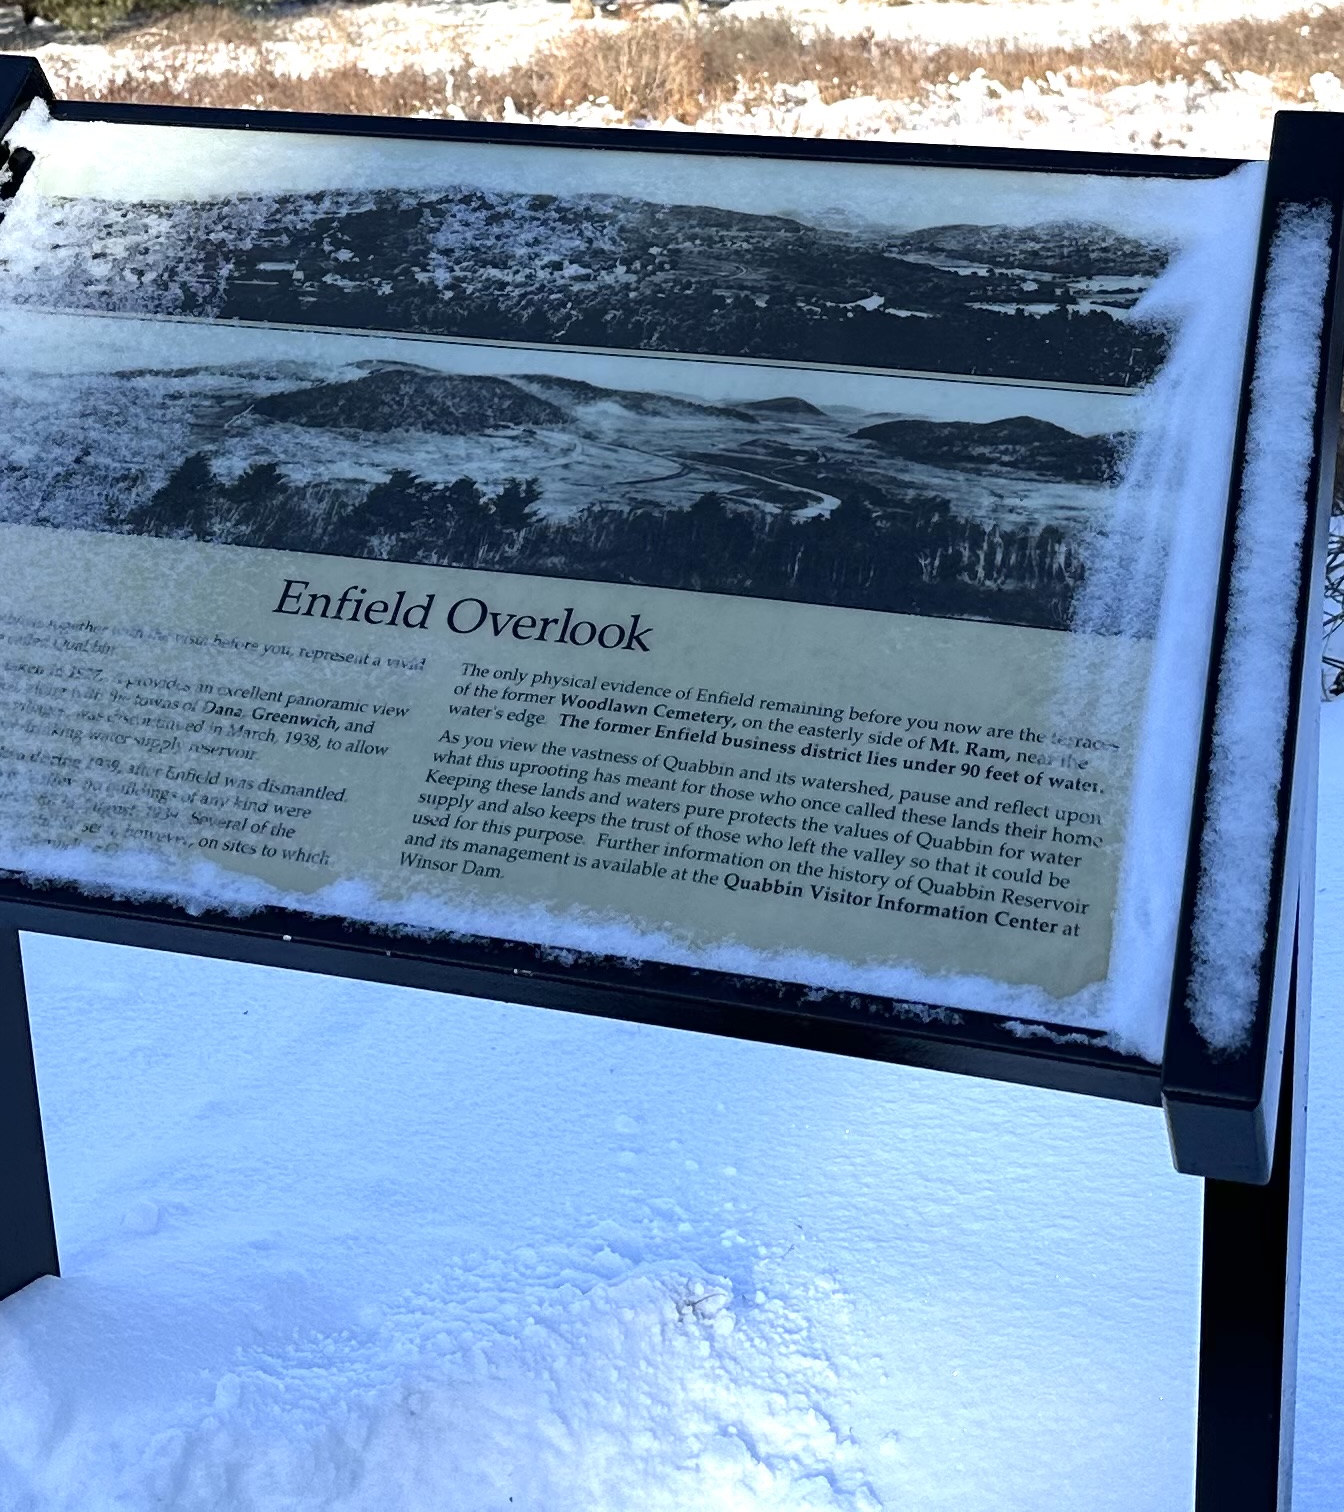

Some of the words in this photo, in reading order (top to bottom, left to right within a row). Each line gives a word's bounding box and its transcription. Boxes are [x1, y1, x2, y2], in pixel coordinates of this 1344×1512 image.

[272, 577, 436, 630] Enfield
[446, 596, 654, 652] Overlook
[298, 646, 370, 665] represent
[371, 655, 382, 667] a
[251, 705, 341, 733] Greenwich,
[343, 719, 376, 734] and
[283, 693, 369, 713] panoramic
[372, 702, 411, 718] view
[452, 681, 473, 695] of
[472, 682, 499, 699] the
[499, 683, 557, 705] former
[560, 691, 648, 716] Woodlawn
[652, 702, 737, 730] Cemetery,
[740, 717, 763, 730] on
[766, 716, 795, 734] the
[796, 721, 865, 747] easterly
[866, 729, 906, 748] side
[906, 734, 928, 750] of
[928, 736, 960, 755] Mt.
[963, 740, 1011, 763] Ram,
[460, 661, 490, 678] The
[491, 666, 529, 686] only
[528, 669, 598, 690] physical
[599, 679, 673, 699] evidence
[674, 685, 694, 701] of
[694, 686, 756, 708] Enfield
[758, 698, 845, 724] remaining
[847, 704, 903, 727] before
[903, 716, 939, 733] you
[942, 720, 983, 735] now
[984, 725, 1014, 740] are
[1018, 726, 1047, 744] the
[284, 730, 322, 751] 1938,
[326, 736, 343, 751] to
[344, 738, 390, 756] allow
[436, 728, 461, 744] As
[460, 734, 494, 750] you
[498, 735, 538, 753] view
[540, 739, 567, 757] the
[570, 746, 639, 765] vastness
[640, 752, 662, 768] of
[661, 754, 735, 777] Quabbin
[737, 766, 772, 783] and
[774, 768, 797, 786] its
[800, 775, 895, 801] watershed,
[896, 788, 952, 806] pause
[953, 794, 989, 811] and
[992, 798, 1050, 819] reflect
[1054, 807, 1102, 827] upon
[558, 712, 590, 730] The
[592, 715, 652, 737] former
[653, 723, 718, 745] Enfield
[720, 730, 797, 755] business
[799, 741, 863, 764] district
[864, 749, 898, 768] lies
[901, 757, 957, 775] under
[959, 761, 981, 778] 90
[983, 763, 1020, 784] feet
[1022, 770, 1045, 787] of
[1047, 775, 1105, 795] water.
[224, 775, 255, 790] was
[233, 794, 269, 813] kind
[273, 803, 312, 820] were
[423, 767, 493, 794] Keeping
[494, 775, 538, 796] these
[539, 780, 586, 801] lands
[587, 790, 622, 806] and
[625, 795, 681, 814] waters
[682, 803, 725, 820] pure
[726, 809, 797, 830] protects
[800, 815, 829, 834] the
[832, 821, 889, 842] values
[892, 828, 914, 845] of
[914, 830, 993, 856] Quabbin
[996, 841, 1026, 860] for
[1028, 849, 1083, 868] water
[432, 746, 473, 766] what
[474, 752, 505, 770] this
[508, 760, 589, 785] uprooting
[592, 766, 621, 785] has
[624, 774, 678, 792] meant
[679, 777, 707, 795] for
[708, 781, 755, 802] those
[758, 789, 797, 807] who
[799, 797, 841, 813] once
[843, 801, 897, 821] called
[900, 806, 947, 827] these
[949, 812, 1000, 835] lands
[1003, 820, 1048, 841] their
[197, 836, 219, 850] on
[221, 838, 258, 855] sites
[261, 843, 278, 858] to
[282, 846, 330, 866] which
[250, 819, 271, 835] of
[269, 821, 297, 839] the
[398, 850, 459, 873] Winsor
[410, 807, 452, 828] used
[451, 811, 479, 831] for
[480, 817, 512, 836] this
[594, 831, 661, 855] Further
[661, 841, 765, 870] information
[767, 859, 791, 874] on
[795, 859, 824, 878] the
[826, 862, 891, 892] history
[893, 873, 915, 891] of
[916, 875, 995, 902] Quabbin
[1000, 886, 1091, 915] Reservoir
[416, 790, 475, 813] supply
[475, 791, 510, 814] and
[510, 800, 546, 818] also
[547, 803, 597, 828] keeps
[599, 810, 627, 829] the
[629, 815, 671, 835] trust
[673, 820, 694, 837] of
[694, 822, 741, 844] those
[744, 831, 784, 850] who
[786, 834, 817, 854] left
[819, 840, 849, 859] the
[852, 846, 906, 871] valley
[908, 856, 931, 870] so
[934, 855, 971, 876] that
[973, 860, 988, 878] it
[990, 866, 1044, 885] could
[1047, 870, 1071, 890] be
[403, 832, 437, 848] and
[438, 835, 460, 851] its
[461, 840, 571, 866] management
[571, 851, 588, 868] is
[589, 857, 668, 879] available
[669, 866, 689, 881] at
[690, 867, 720, 886] the
[722, 871, 803, 898] Quabbin
[808, 883, 873, 908] Visitor
[874, 892, 989, 925] Information
[993, 909, 1059, 934] Center
[1060, 922, 1081, 937] at
